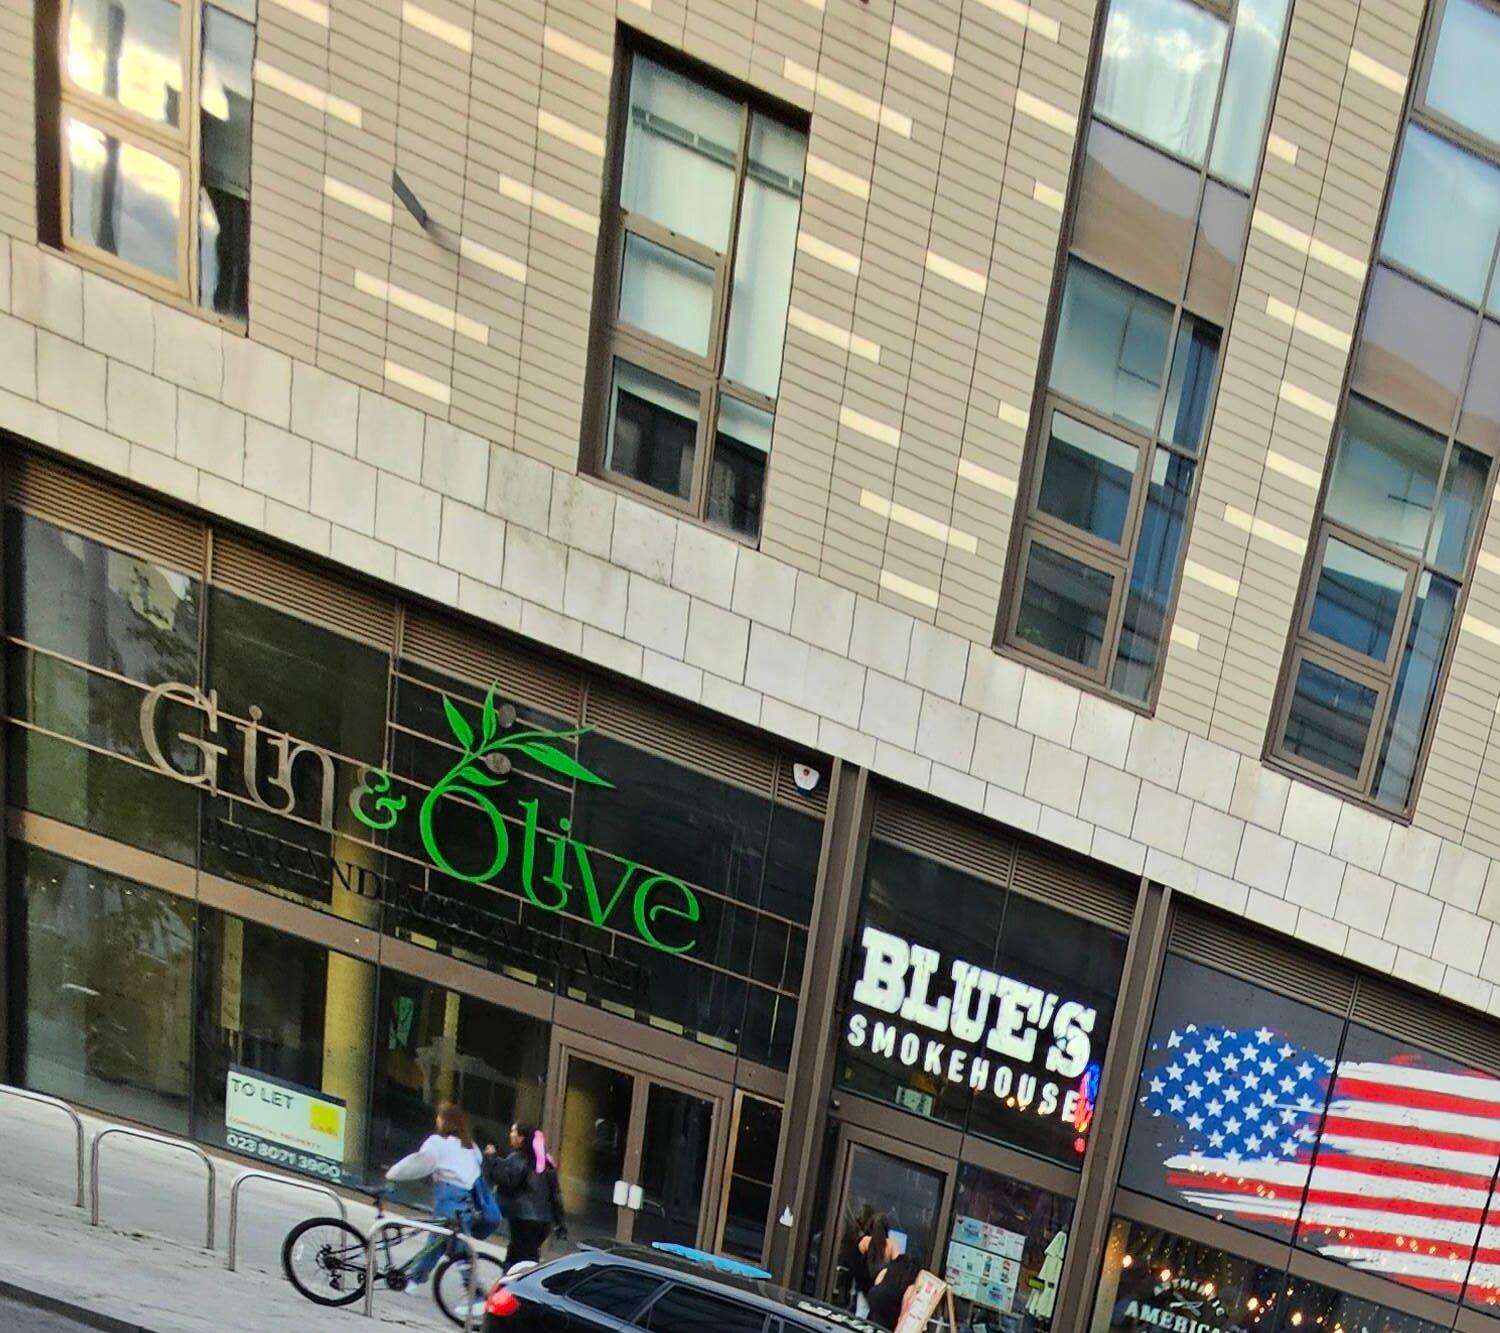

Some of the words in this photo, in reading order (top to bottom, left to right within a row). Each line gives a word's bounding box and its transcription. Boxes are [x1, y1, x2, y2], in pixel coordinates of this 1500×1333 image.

[140, 681, 336, 831] Gin
[349, 767, 406, 830] &
[419, 784, 700, 955] Olive
[853, 926, 1097, 1078] BLUE'S
[231, 1078, 256, 1097] TO
[261, 1087, 294, 1110] LET
[847, 1013, 1082, 1124] SMOKEHOUSE
[226, 1133, 257, 1153] 023
